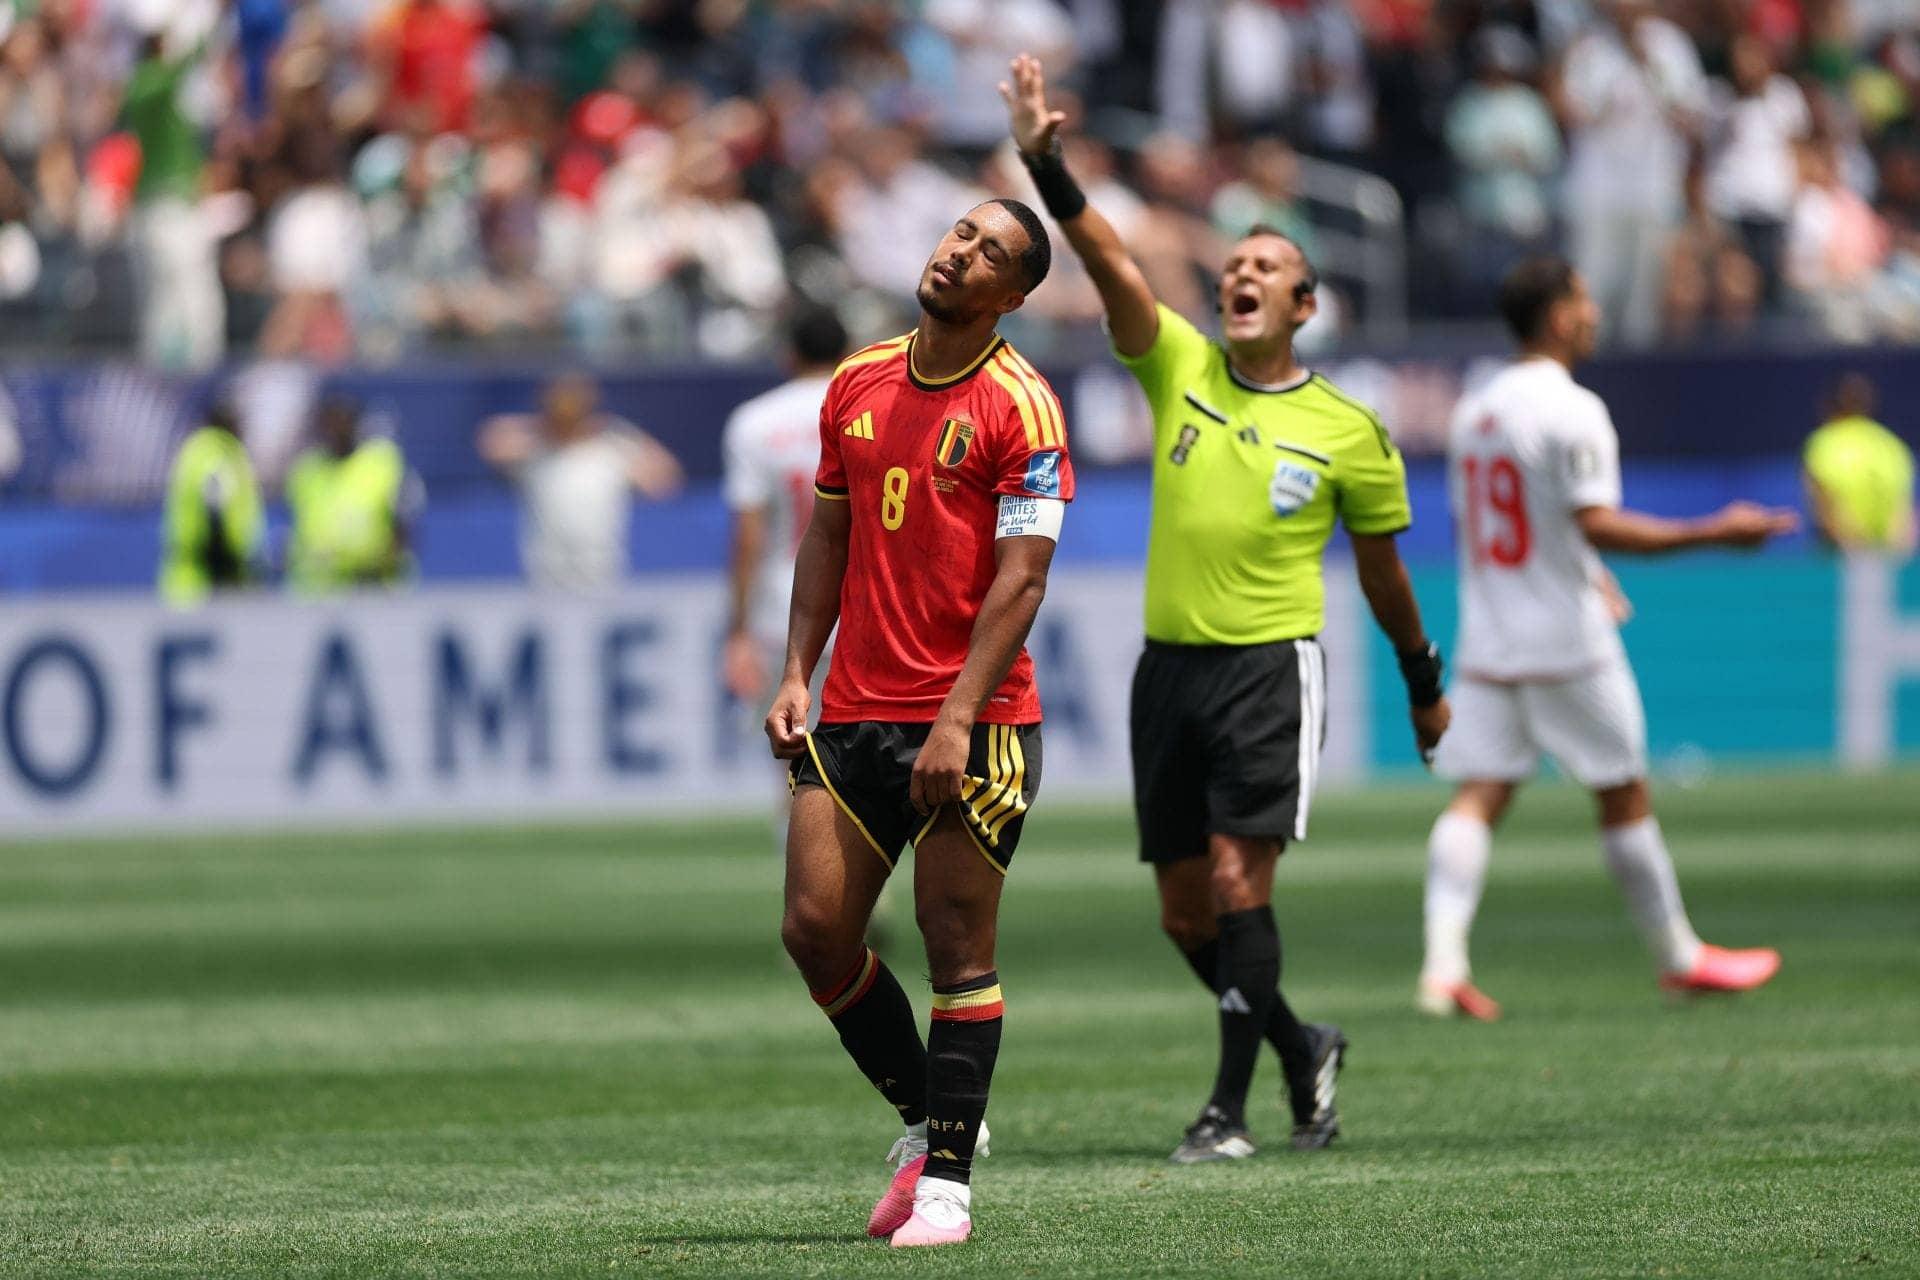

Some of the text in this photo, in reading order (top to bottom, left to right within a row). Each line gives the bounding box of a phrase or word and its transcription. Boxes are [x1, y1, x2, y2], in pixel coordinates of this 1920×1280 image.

[882, 467, 909, 531] 8
[1001, 503, 1037, 517] UNITES
[1011, 514, 1039, 526] World
[1462, 454, 1531, 570] 19
[3, 633, 219, 798] OF
